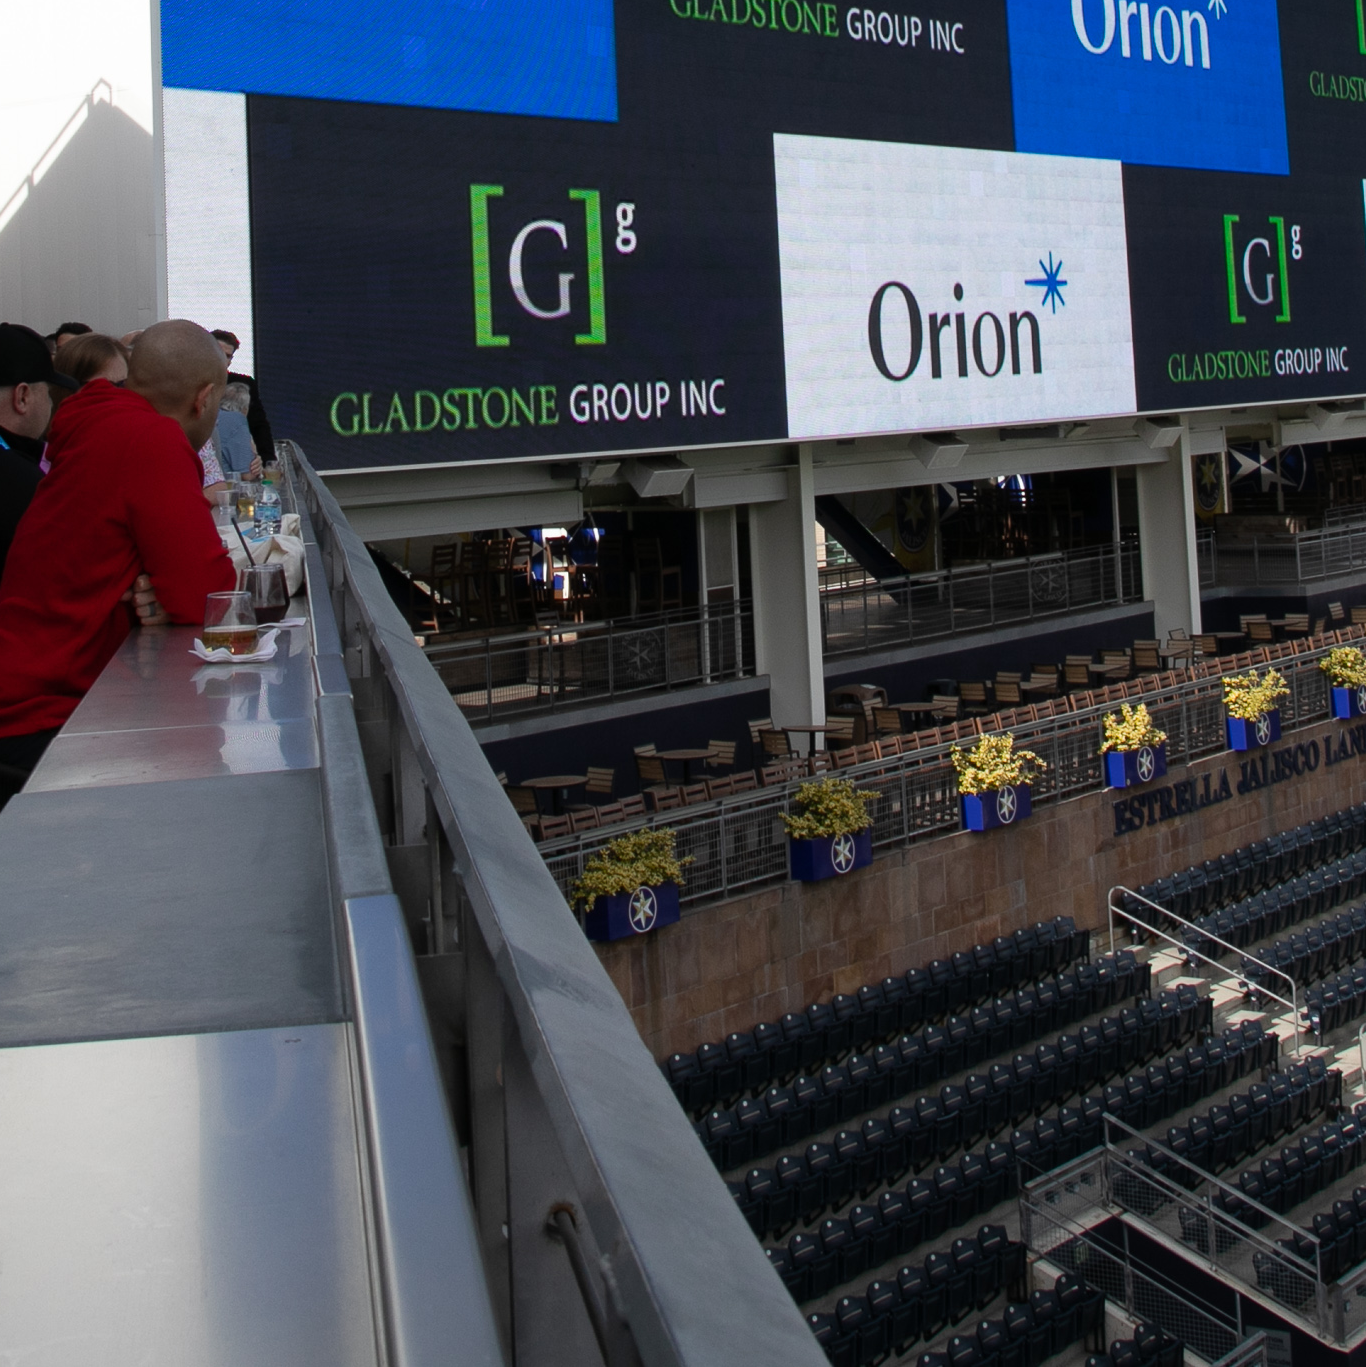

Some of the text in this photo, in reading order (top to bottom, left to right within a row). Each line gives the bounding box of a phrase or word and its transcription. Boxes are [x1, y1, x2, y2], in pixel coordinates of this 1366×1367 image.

[846, 7, 923, 49] GROUP
[930, 18, 965, 54] INC
[868, 280, 1043, 382] Orion
[1168, 346, 1349, 383] GLADSTONE GROUP INC
[330, 378, 727, 437] GLADSTONE GROUP INC
[1113, 766, 1233, 836] ESTRELLA
[1237, 739, 1321, 795] JALISCO
